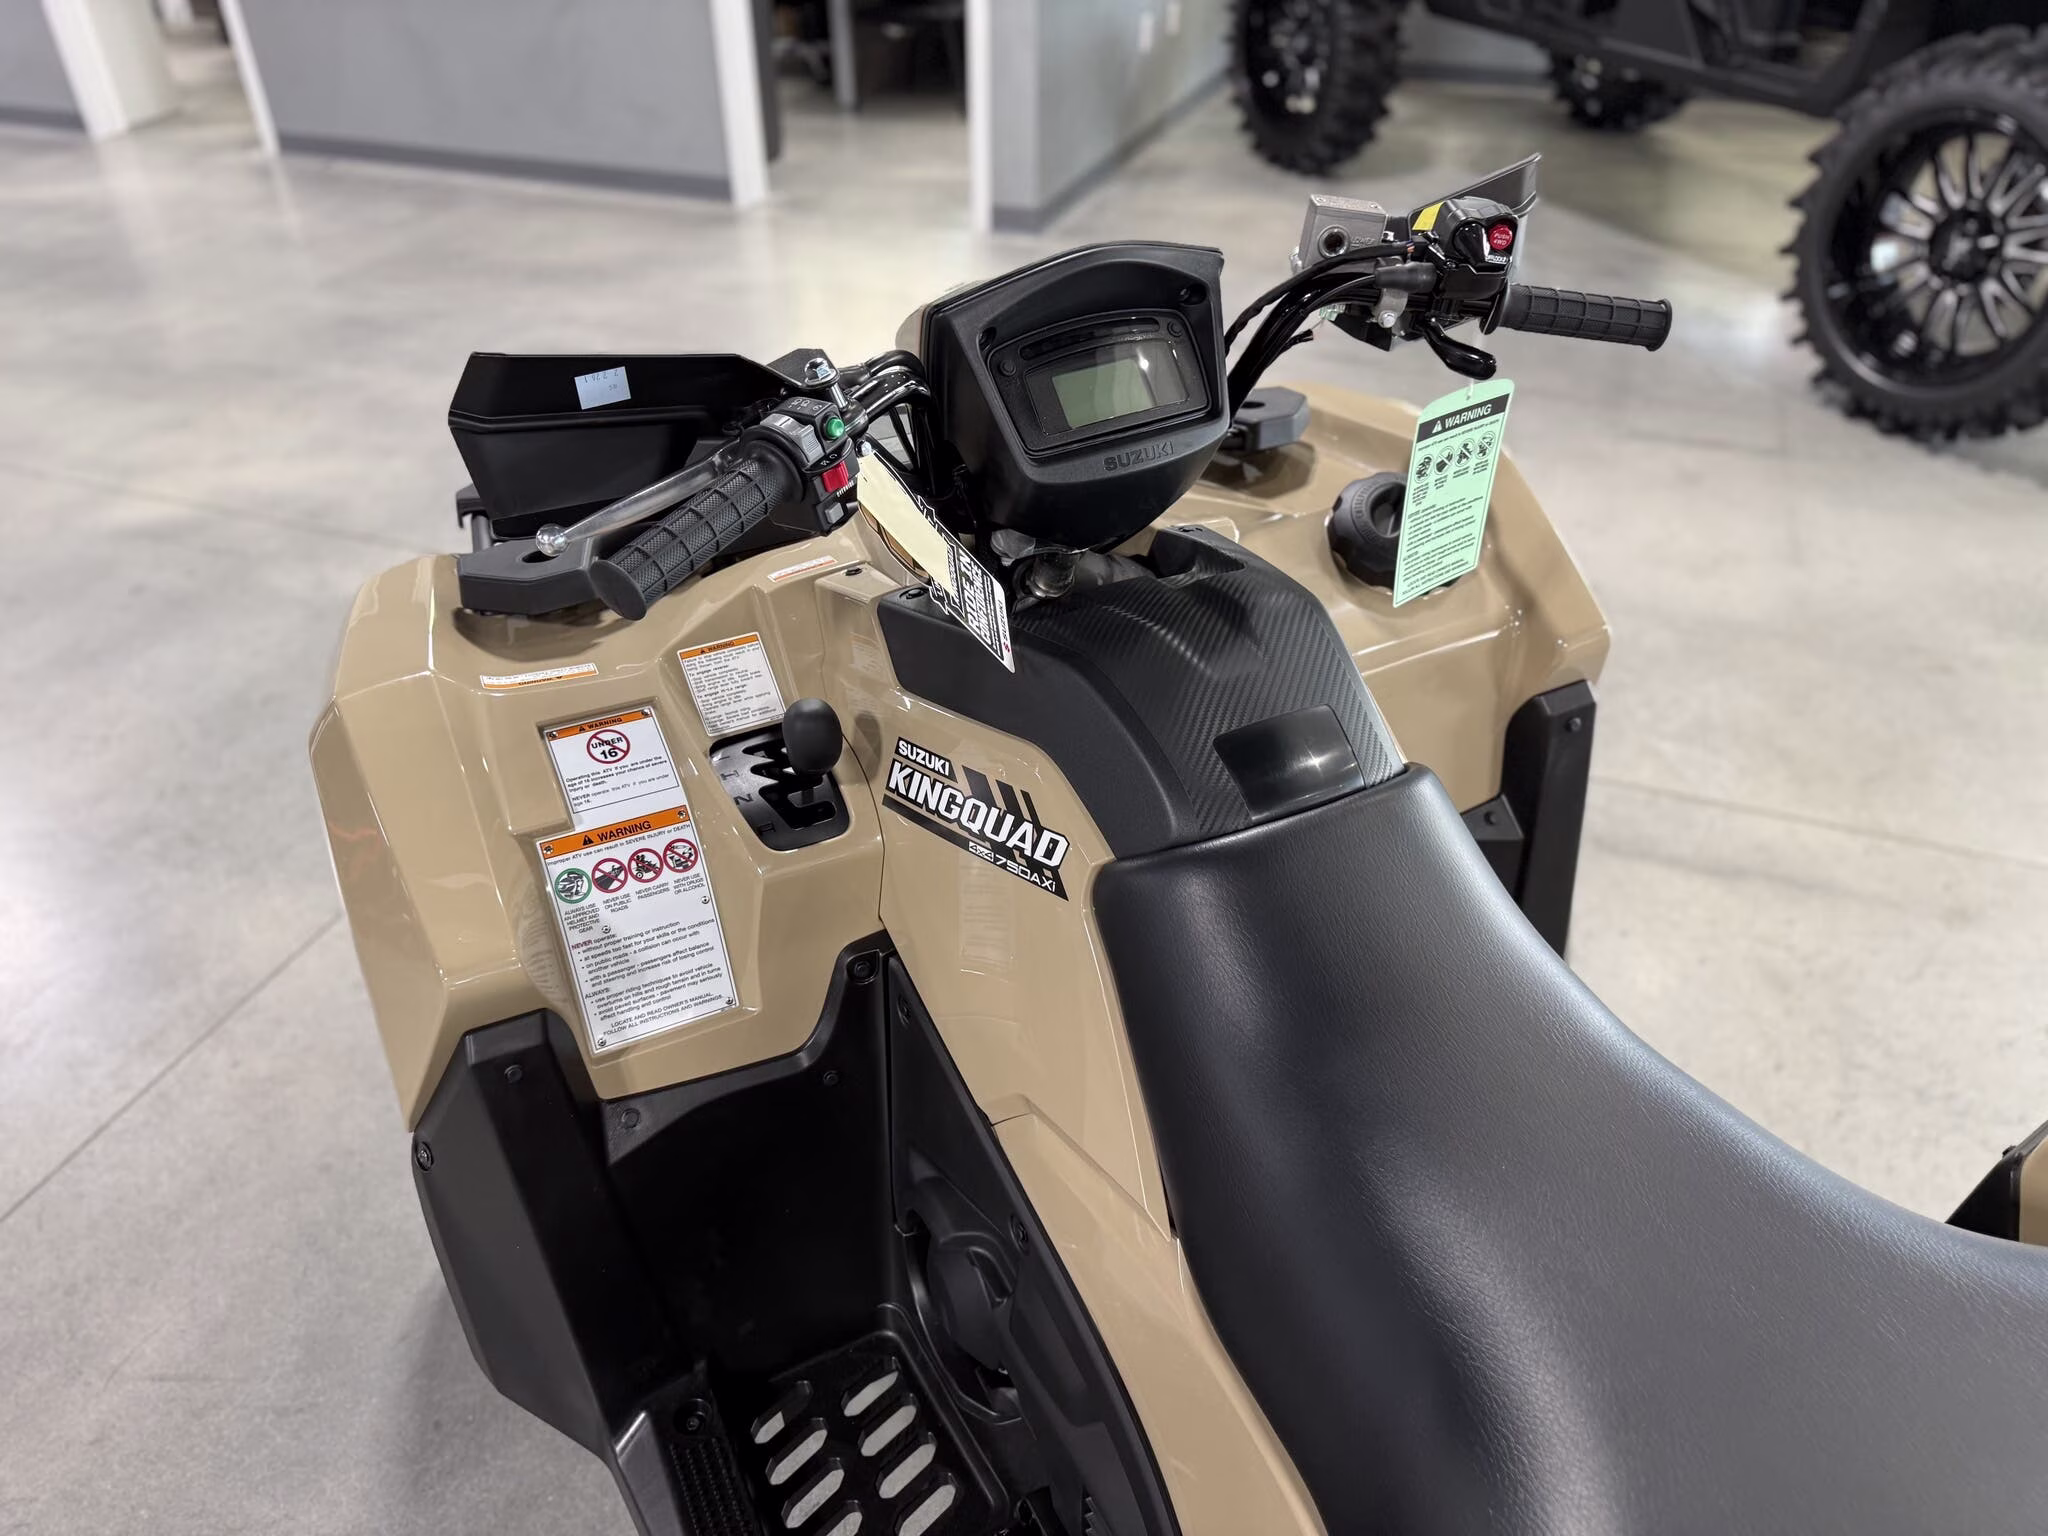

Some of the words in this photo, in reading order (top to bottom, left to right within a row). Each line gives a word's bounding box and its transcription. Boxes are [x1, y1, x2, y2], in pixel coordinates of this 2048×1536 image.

[1445, 404, 1492, 428] WARNING
[1103, 441, 1174, 471] SUZUKI
[959, 548, 974, 585] IN
[962, 577, 981, 636] RIDE
[971, 561, 991, 646] CONFIDENCE
[587, 717, 623, 729] WARNING
[591, 737, 624, 750] UNDER
[600, 748, 618, 760] 16
[898, 740, 950, 776] SUZUKI
[889, 762, 1070, 868] KINGQUAD
[597, 820, 652, 842] WARNING
[604, 843, 619, 851] result
[626, 836, 646, 845] SEVERE
[647, 830, 666, 839] INJURY
[673, 824, 691, 832] DEATH
[674, 876, 690, 884] NEVER
[687, 878, 704, 886] DRUGS
[995, 856, 1056, 892] 750AXi
[636, 887, 652, 895] NEVER
[638, 887, 670, 900] PASSENGERS
[683, 882, 705, 893] ALCOHOL
[564, 906, 585, 916] ALWAYS
[603, 896, 620, 904] NEVER
[611, 905, 629, 913] ROADS
[614, 898, 632, 907] PUBLIC
[567, 916, 588, 926] HELMET
[569, 918, 600, 931] PROTECTIVE
[573, 907, 600, 919] APPROVED
[579, 926, 593, 934] GEAR
[582, 944, 603, 954] without
[604, 939, 622, 948] proper
[623, 932, 644, 942] training
[652, 921, 680, 933] instruction
[591, 949, 612, 960] speeds
[643, 937, 656, 945] your
[656, 931, 670, 939] skills
[687, 918, 715, 930] conditions
[572, 939, 593, 950] NEVER
[594, 957, 612, 967] public
[613, 952, 628, 960] roads
[638, 943, 660, 953] collision
[588, 965, 609, 975] another
[611, 958, 630, 968] vehicle
[603, 974, 626, 985] steering
[638, 963, 660, 973] increase
[679, 952, 695, 961] losing
[696, 946, 714, 955] control
[607, 965, 636, 978] passenger
[641, 953, 671, 967] passengers
[673, 948, 688, 956] affect
[689, 942, 709, 952] balance
[597, 997, 623, 1009] overturns
[656, 982, 672, 991] rough
[672, 976, 689, 985] terrain
[607, 991, 625, 1000] proper
[626, 985, 642, 994] riding
[642, 976, 671, 989] techniques
[679, 969, 694, 977] avoid
[695, 963, 713, 972] vehicle
[599, 1007, 614, 1015] avoid
[615, 1001, 632, 1010] paved
[633, 994, 655, 1004] surfaces
[660, 984, 686, 996] pavement
[687, 980, 699, 988] may
[700, 973, 723, 984] seriously
[600, 1012, 616, 1021] affect
[617, 1005, 641, 1017] handling
[652, 994, 672, 1004] control
[611, 1017, 633, 1028] LOCATE
[634, 1013, 646, 1021] AND
[647, 1008, 662, 1016] READ
[663, 999, 689, 1011] OWNER'S
[604, 1025, 627, 1036] FOLLOW
[639, 1008, 679, 1024] INSTRUCTIONS
